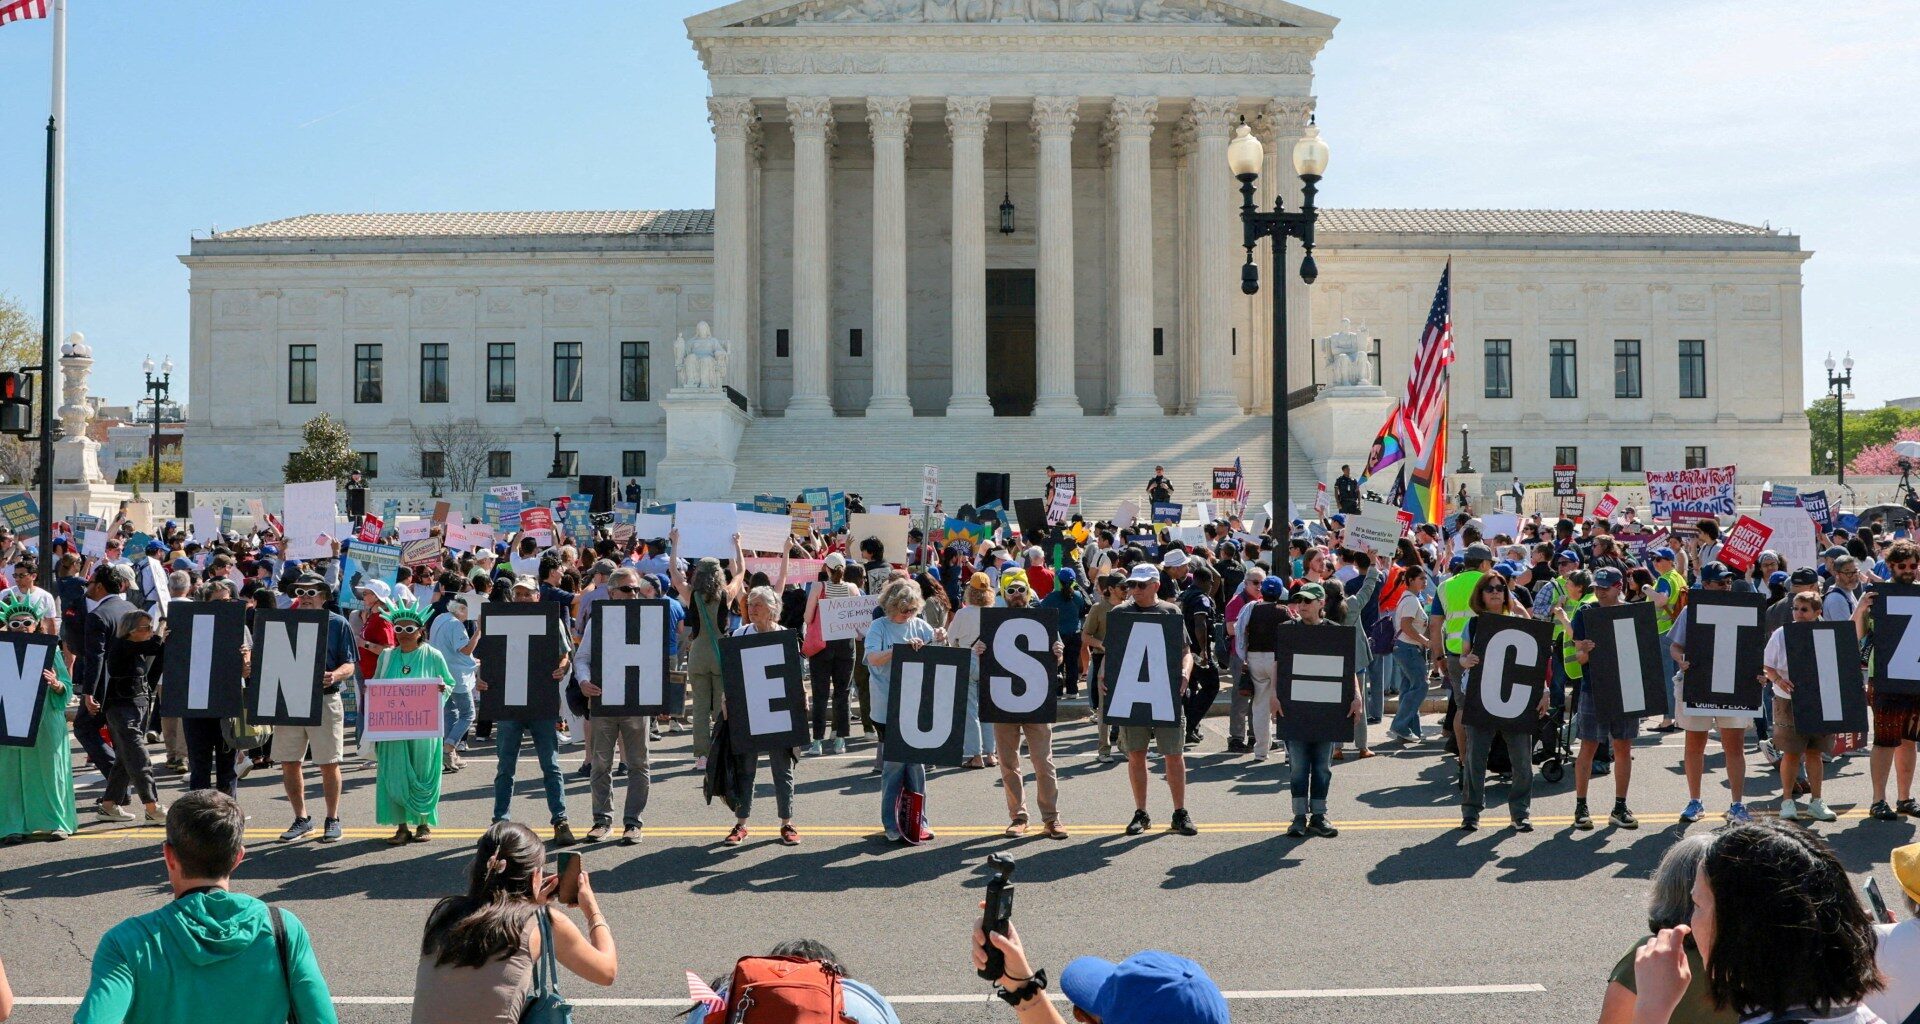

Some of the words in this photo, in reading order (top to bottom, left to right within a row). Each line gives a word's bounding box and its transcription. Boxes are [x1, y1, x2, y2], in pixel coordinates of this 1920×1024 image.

[1048, 510, 1064, 521] ALL
[1360, 534, 1395, 544] Constitution.
[1365, 529, 1387, 538] literally
[1728, 535, 1760, 557] RIGHT
[1734, 525, 1765, 547] BIRTH
[1771, 517, 1808, 538] ICE
[188, 615, 214, 709] I
[257, 621, 319, 718] N
[370, 684, 427, 697] CITIZENSHIP
[486, 616, 547, 706] T
[602, 606, 663, 705] H
[740, 644, 792, 736] E
[990, 618, 1049, 713] S
[1107, 622, 1175, 722] A
[1481, 629, 1538, 718] C
[1613, 618, 1645, 712] I
[1696, 604, 1757, 694] T
[1813, 629, 1843, 721] I
[369, 710, 432, 727] BIRTHRIGHT
[388, 700, 395, 708] IS
[899, 662, 957, 748] U
